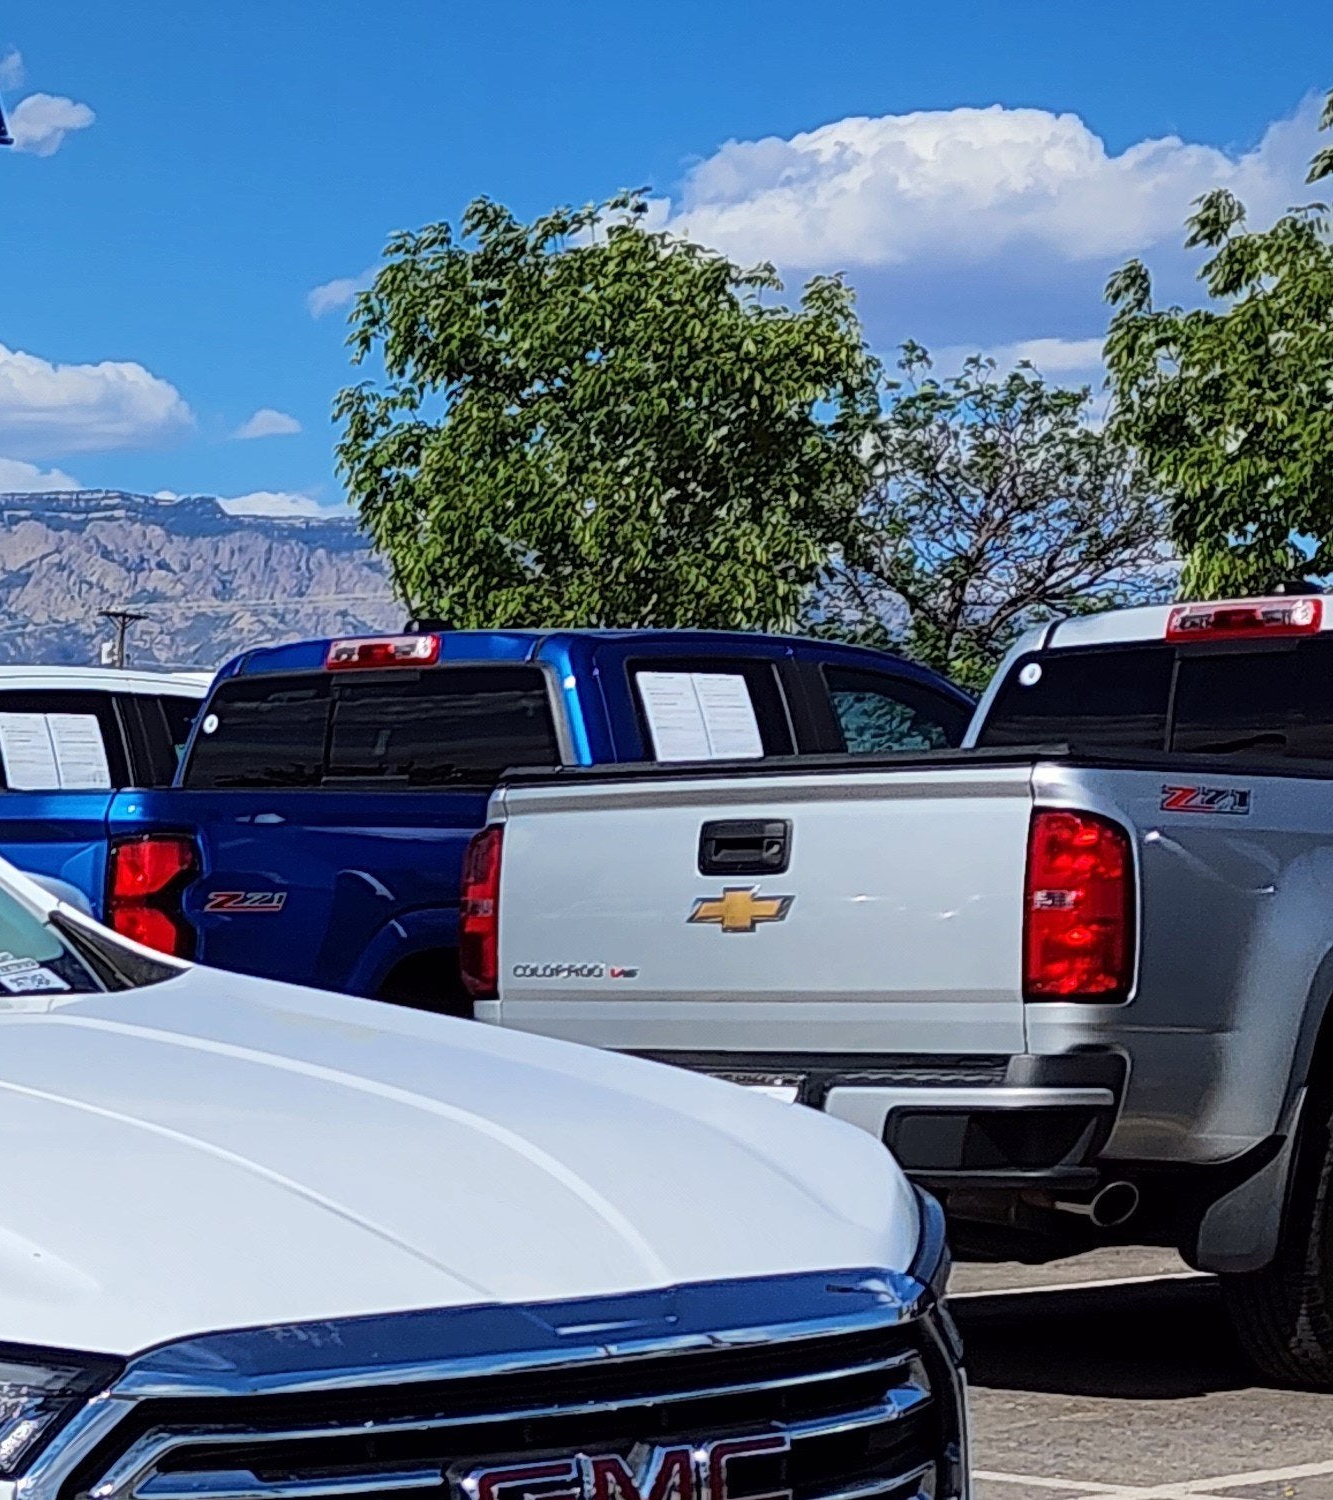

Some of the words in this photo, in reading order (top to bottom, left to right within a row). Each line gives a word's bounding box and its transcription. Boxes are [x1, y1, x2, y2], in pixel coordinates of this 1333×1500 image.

[1159, 783, 1252, 816] Z71
[202, 891, 288, 912] Z71
[512, 963, 605, 979] COLORADO
